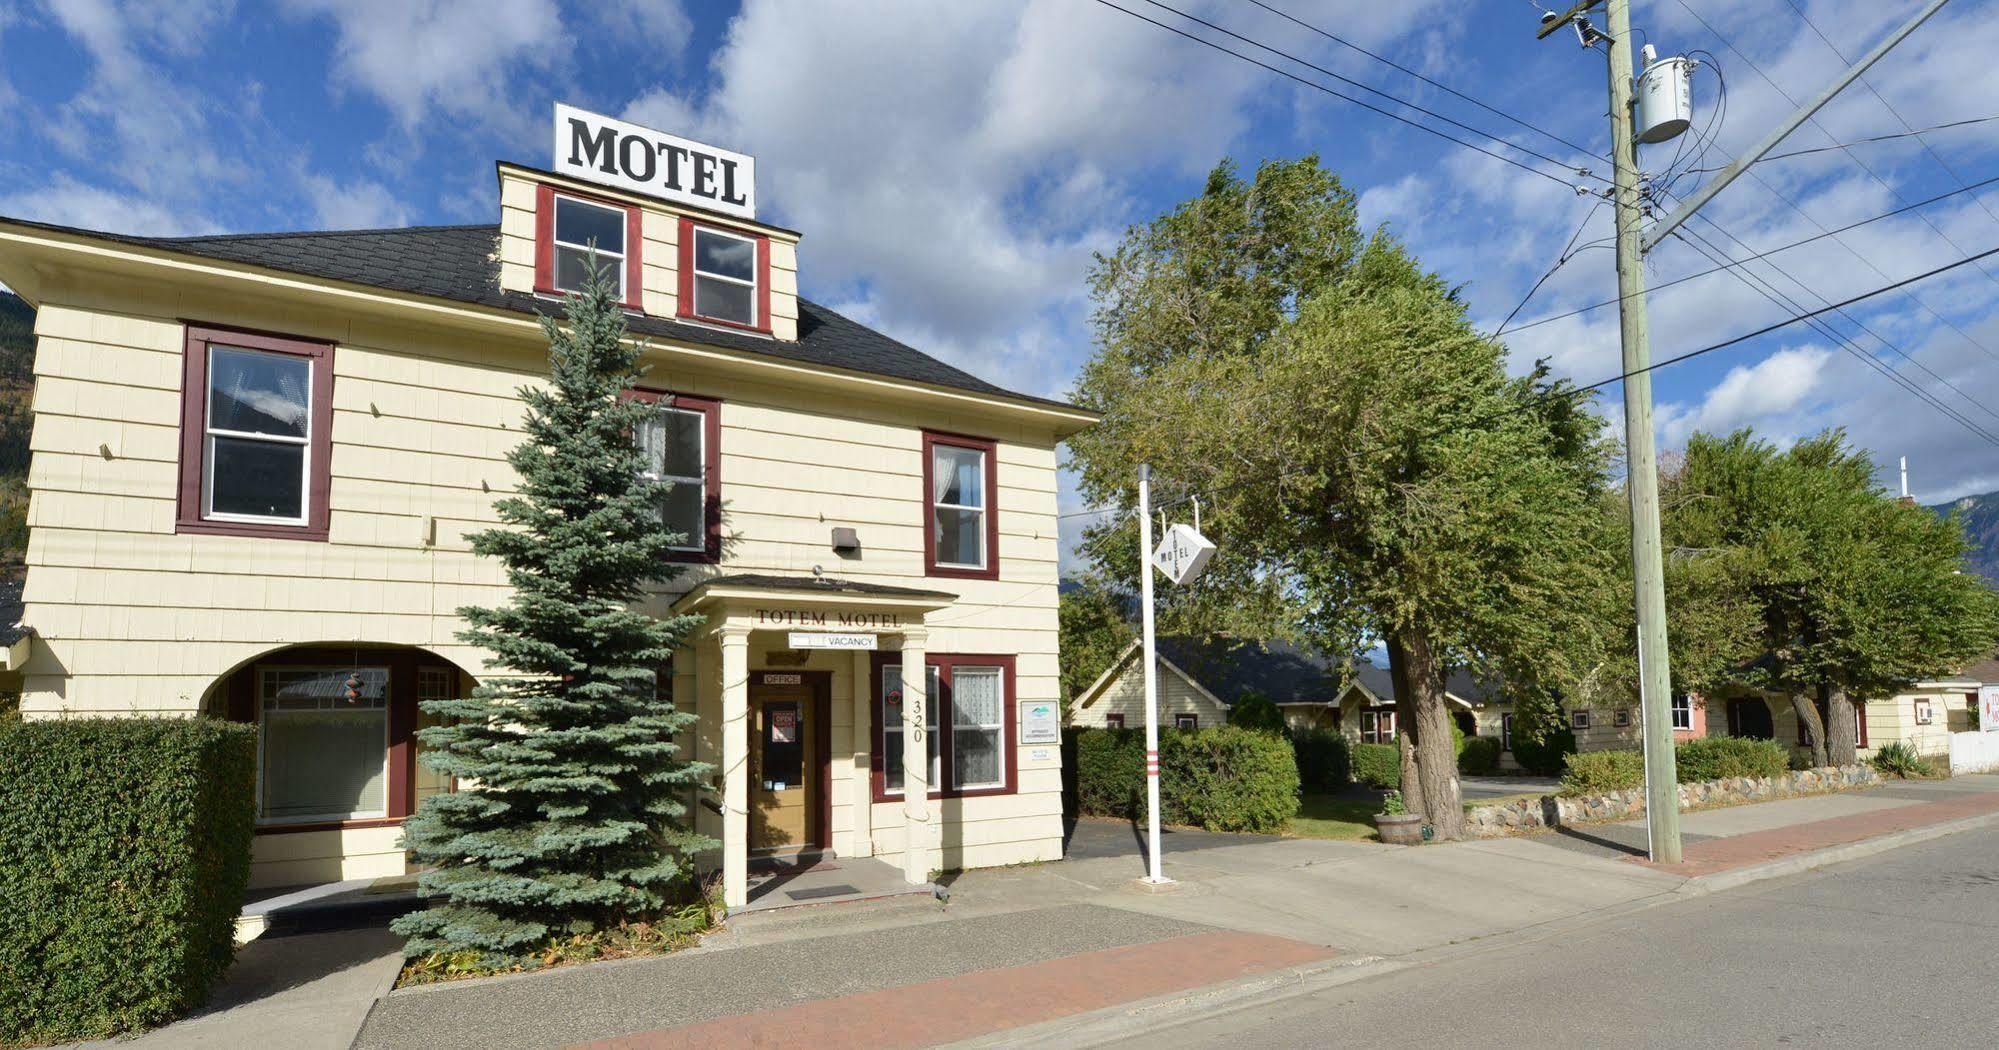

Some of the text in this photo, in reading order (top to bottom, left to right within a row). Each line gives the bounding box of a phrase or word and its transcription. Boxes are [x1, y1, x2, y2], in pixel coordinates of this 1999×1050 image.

[568, 117, 746, 207] MOTEL
[1161, 547, 1188, 562] MOTEL
[756, 609, 901, 628] TOTEM MOTEL
[828, 637, 873, 646] VACANCY
[766, 675, 800, 683] OFFICE
[913, 700, 922, 743] 320
